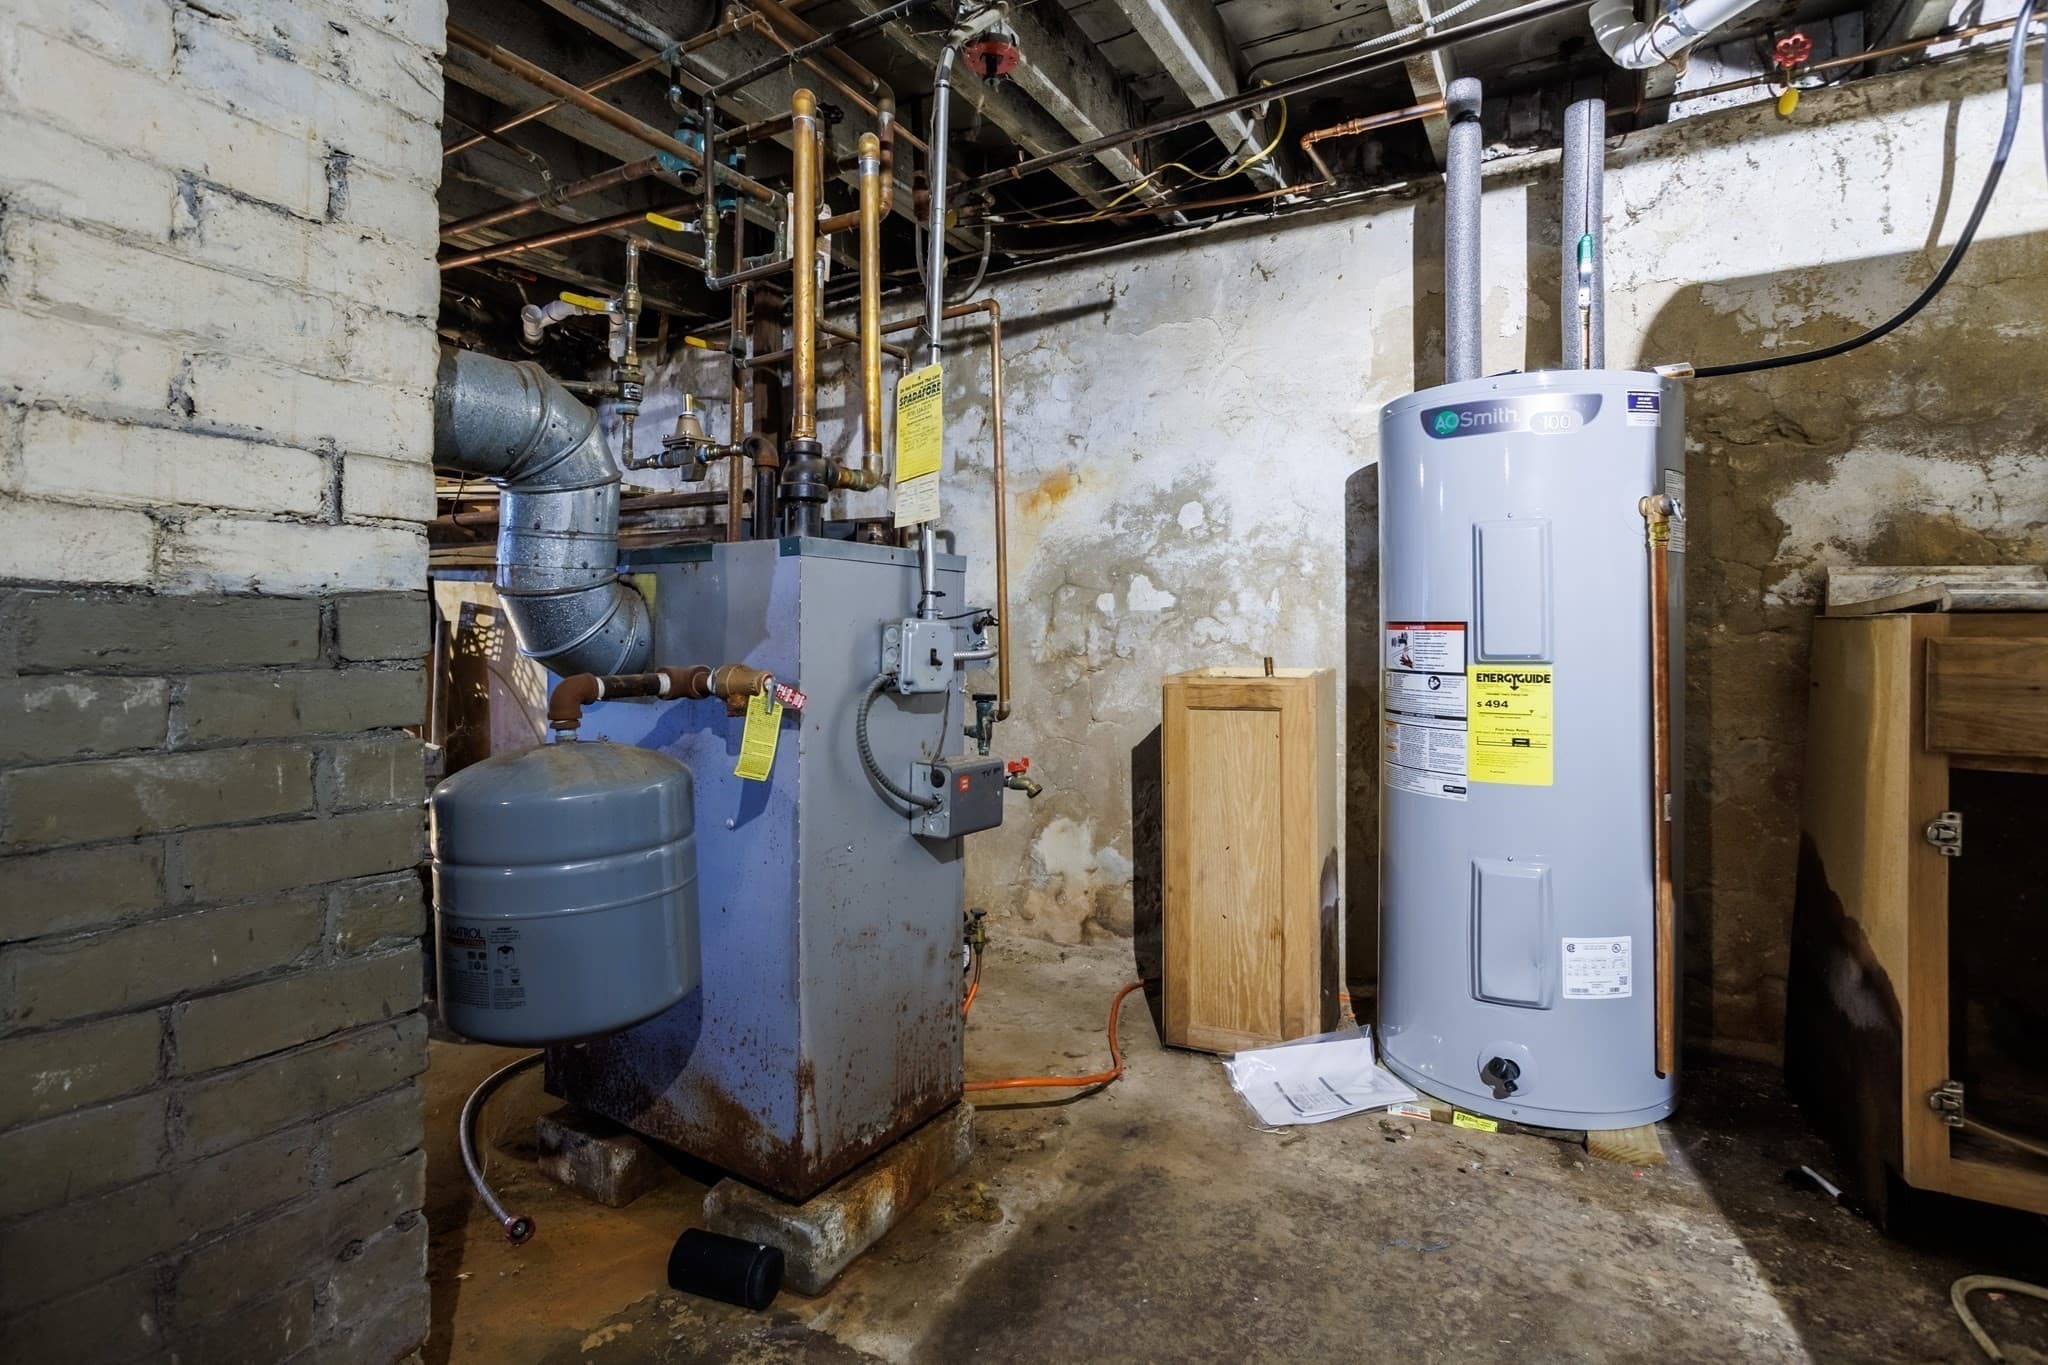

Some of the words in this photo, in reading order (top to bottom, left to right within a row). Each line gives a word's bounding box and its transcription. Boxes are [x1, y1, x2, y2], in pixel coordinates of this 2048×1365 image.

[899, 382, 941, 407] SPADAFORE
[1476, 673, 1551, 685] ENERGYGUIDE
[1485, 700, 1509, 708] 494
